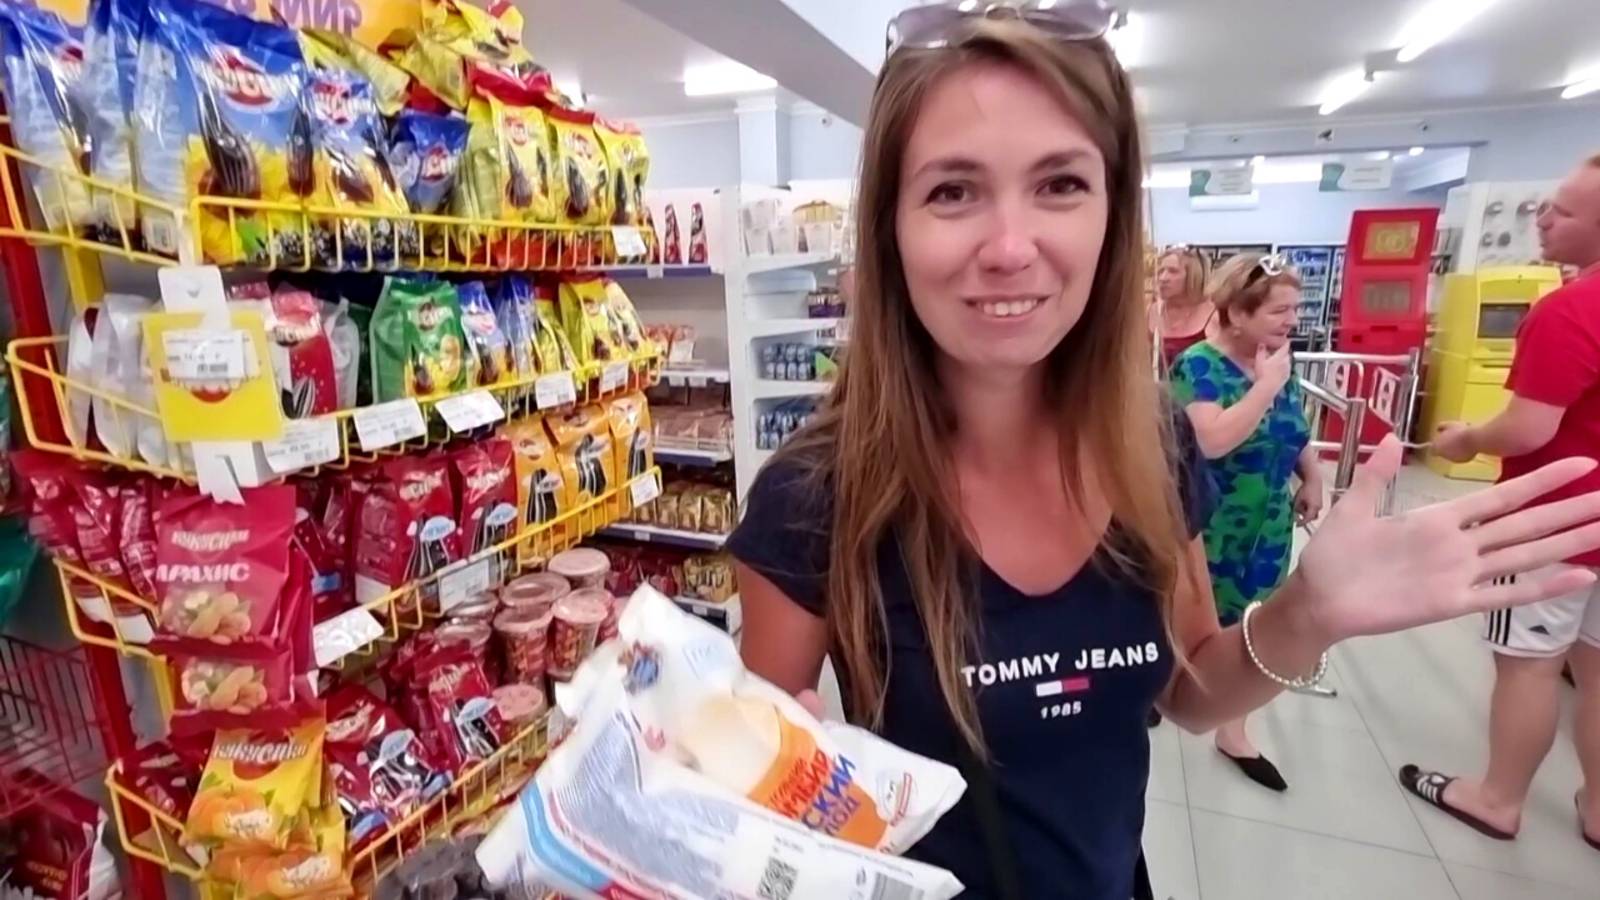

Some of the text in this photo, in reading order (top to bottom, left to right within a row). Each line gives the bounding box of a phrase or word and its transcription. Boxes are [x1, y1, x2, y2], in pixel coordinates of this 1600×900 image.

[156, 563, 250, 582] АРАХИС
[961, 642, 1159, 687] TOMMY JEANS
[1041, 701, 1082, 719] 1985
